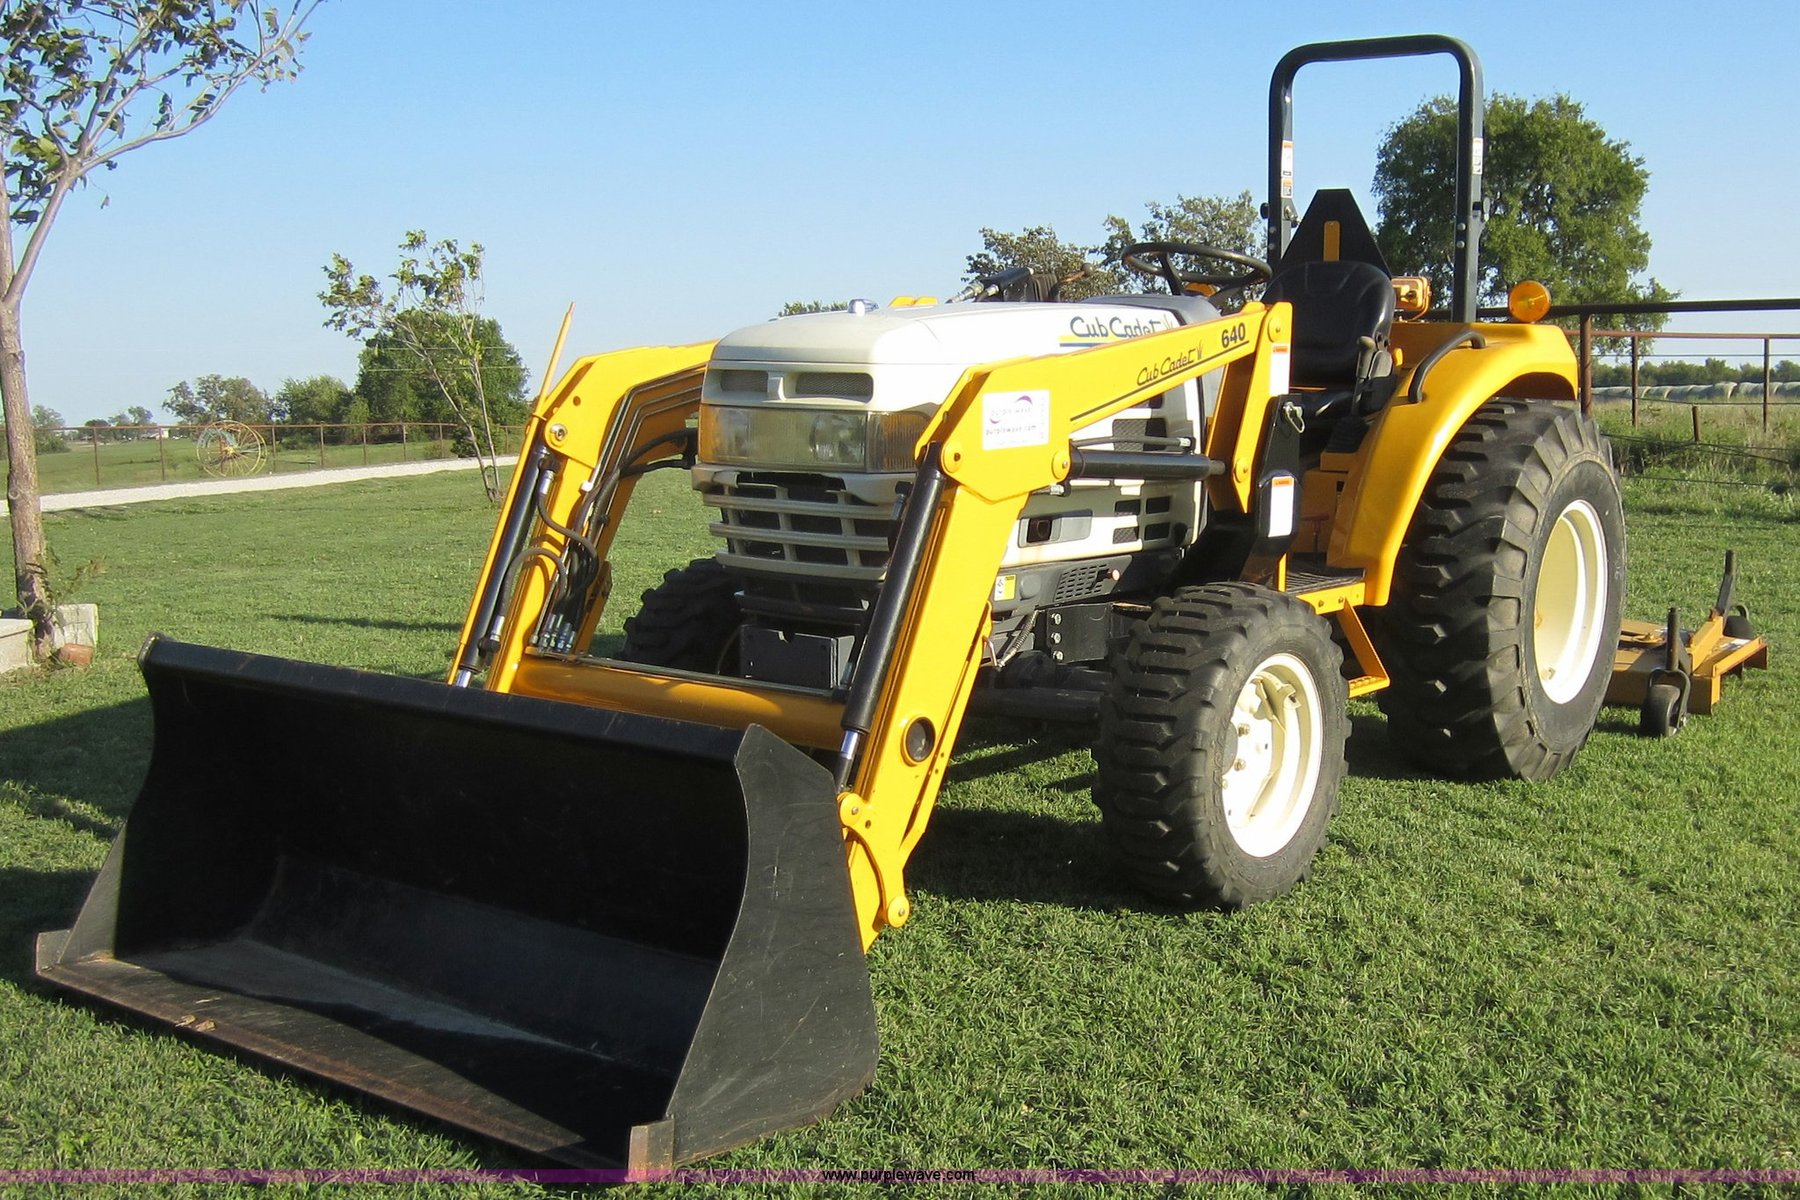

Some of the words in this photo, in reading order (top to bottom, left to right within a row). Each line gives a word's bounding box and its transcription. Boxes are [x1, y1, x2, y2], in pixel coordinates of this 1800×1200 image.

[1070, 316, 1109, 337] Cub
[1109, 316, 1161, 338] Cadet
[1221, 322, 1246, 348] 640
[1137, 363, 1159, 386] Cub
[1160, 347, 1196, 375] Cadet
